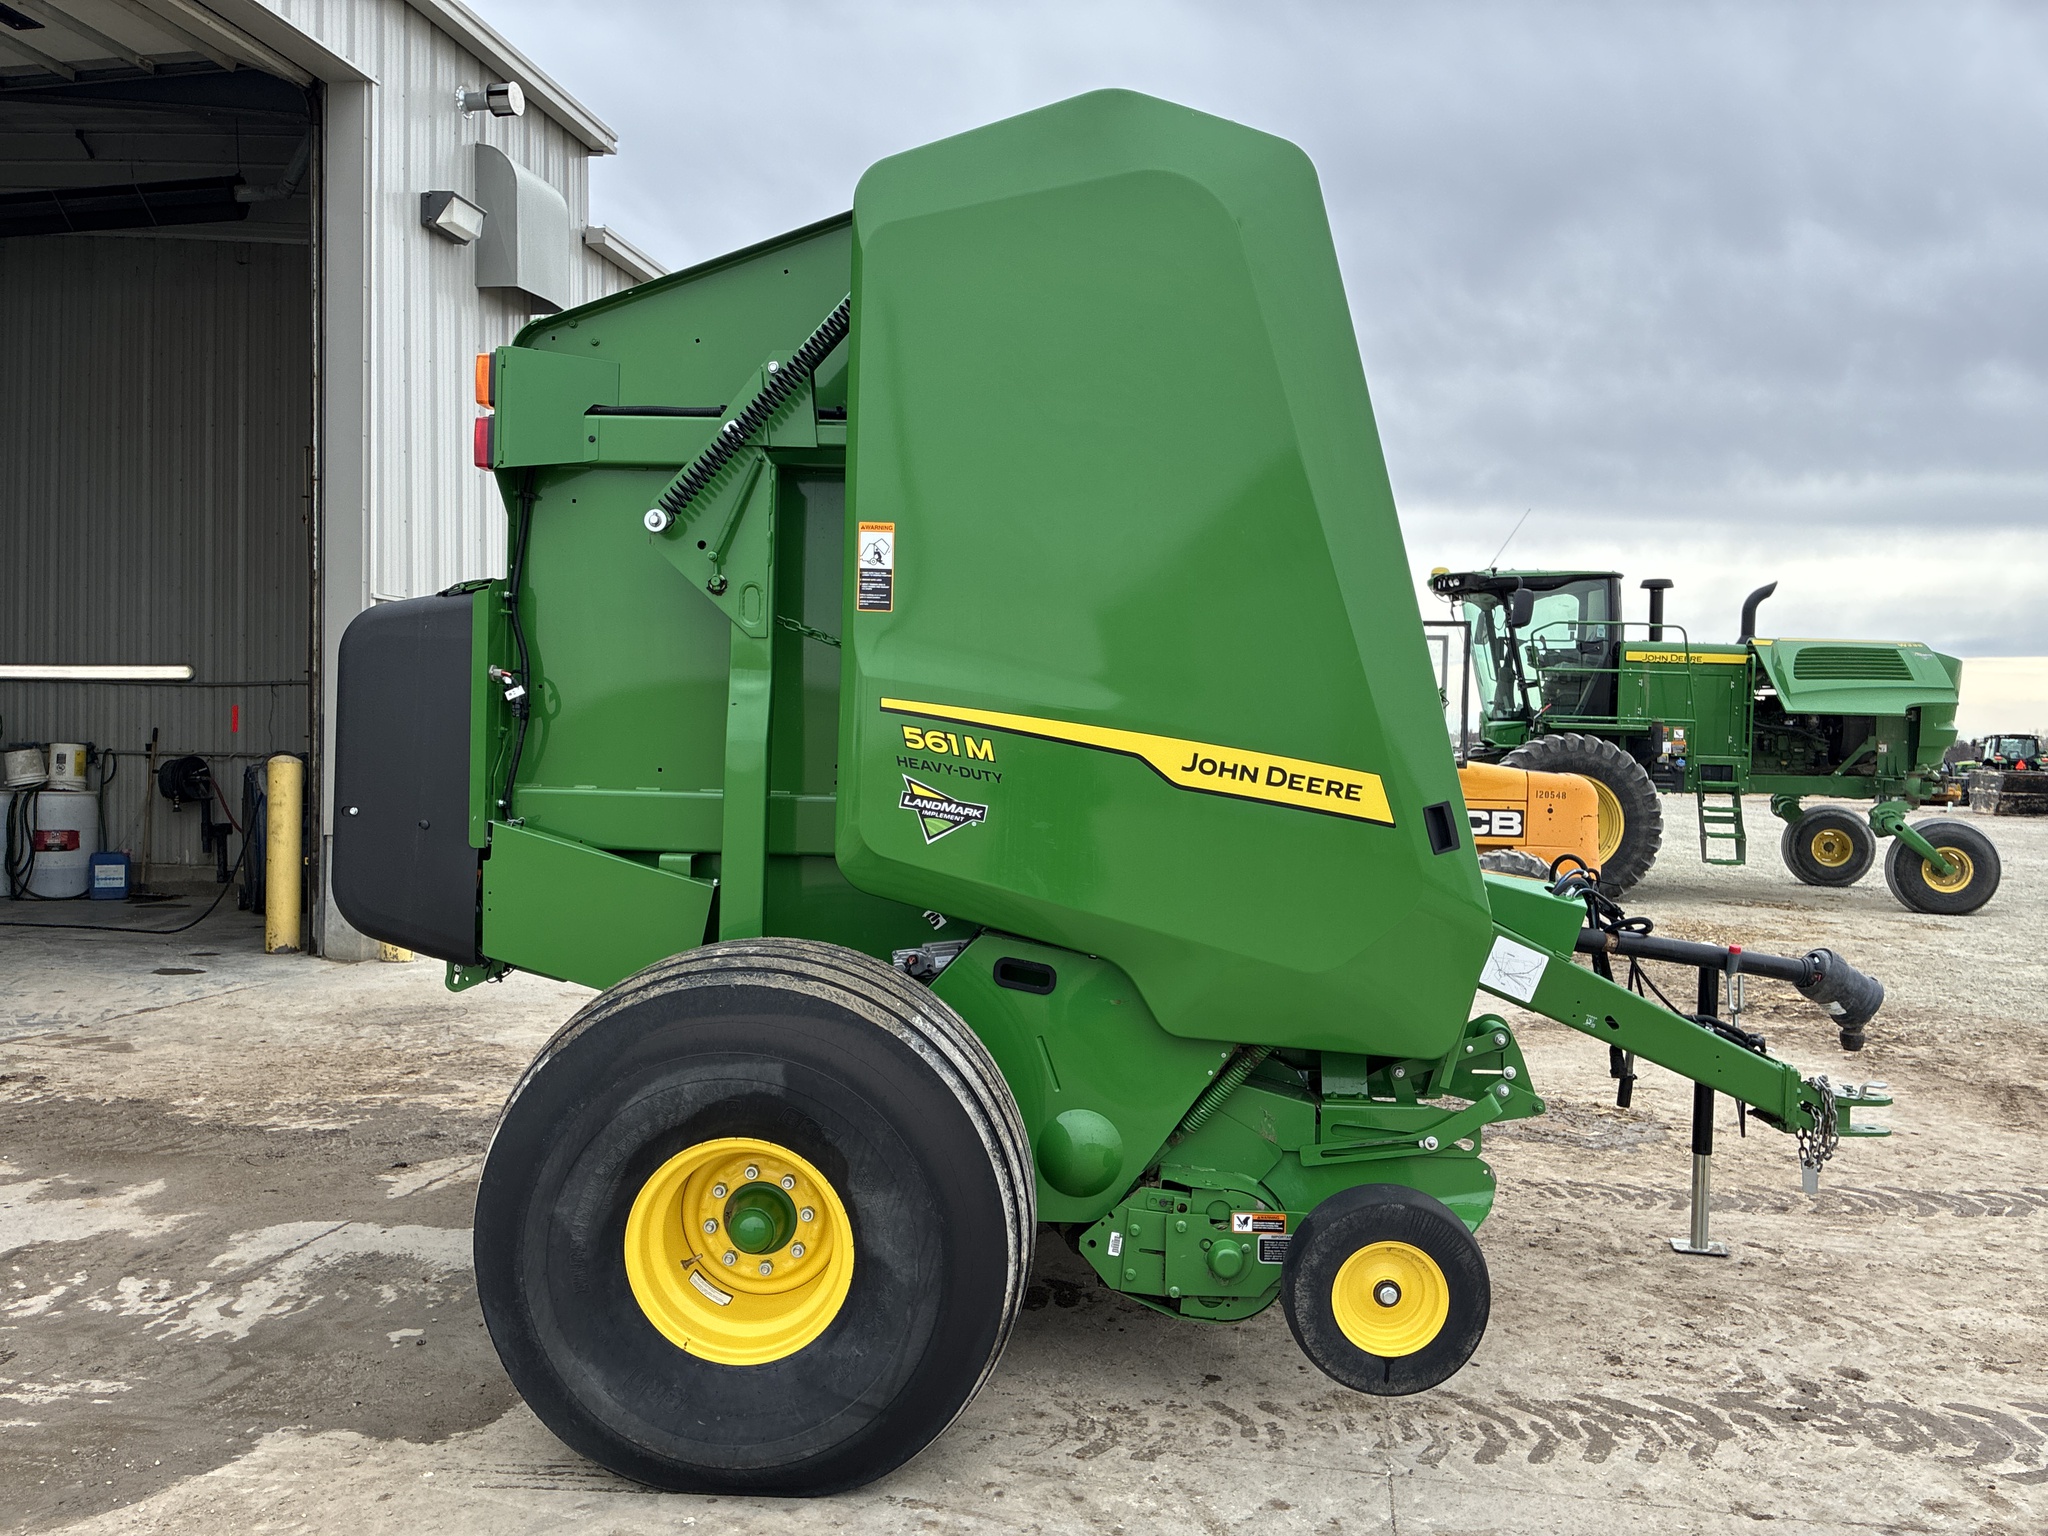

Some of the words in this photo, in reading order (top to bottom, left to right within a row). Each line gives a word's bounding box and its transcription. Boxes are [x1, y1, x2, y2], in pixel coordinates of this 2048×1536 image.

[1642, 653, 1668, 661] JOHN
[896, 756, 1002, 783] HEAVY-DUTY
[1181, 753, 1259, 784] JOHN
[1265, 765, 1363, 802] DEERE
[1535, 790, 1567, 800] 120548
[921, 810, 965, 822] IMPLEMENT
[1467, 810, 1522, 836] CB
